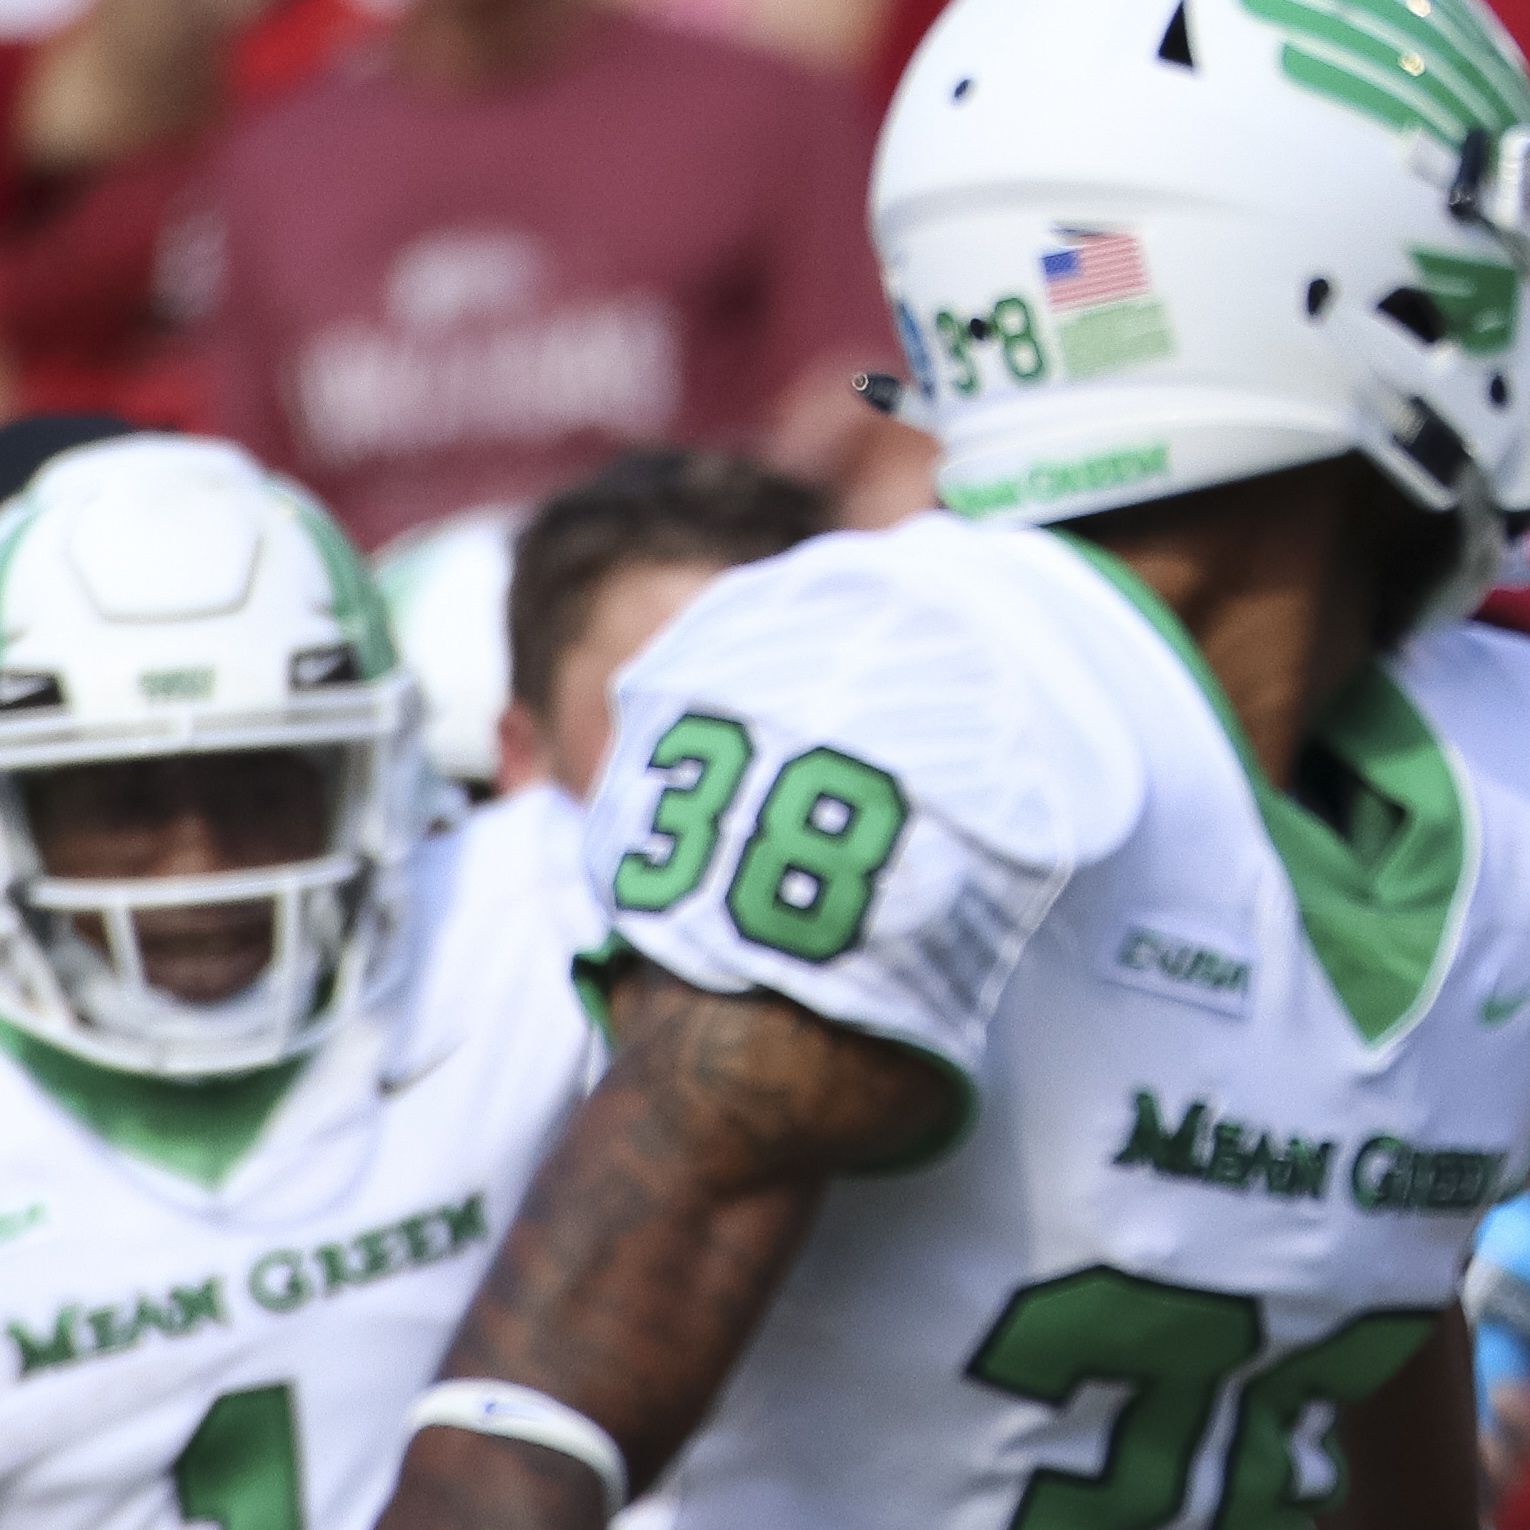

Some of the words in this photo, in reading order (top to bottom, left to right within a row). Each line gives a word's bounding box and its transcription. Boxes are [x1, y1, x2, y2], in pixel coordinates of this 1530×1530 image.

[613, 712, 910, 964] 38
[6, 1272, 231, 1383] MEAN
[248, 1192, 487, 1314] GREEN
